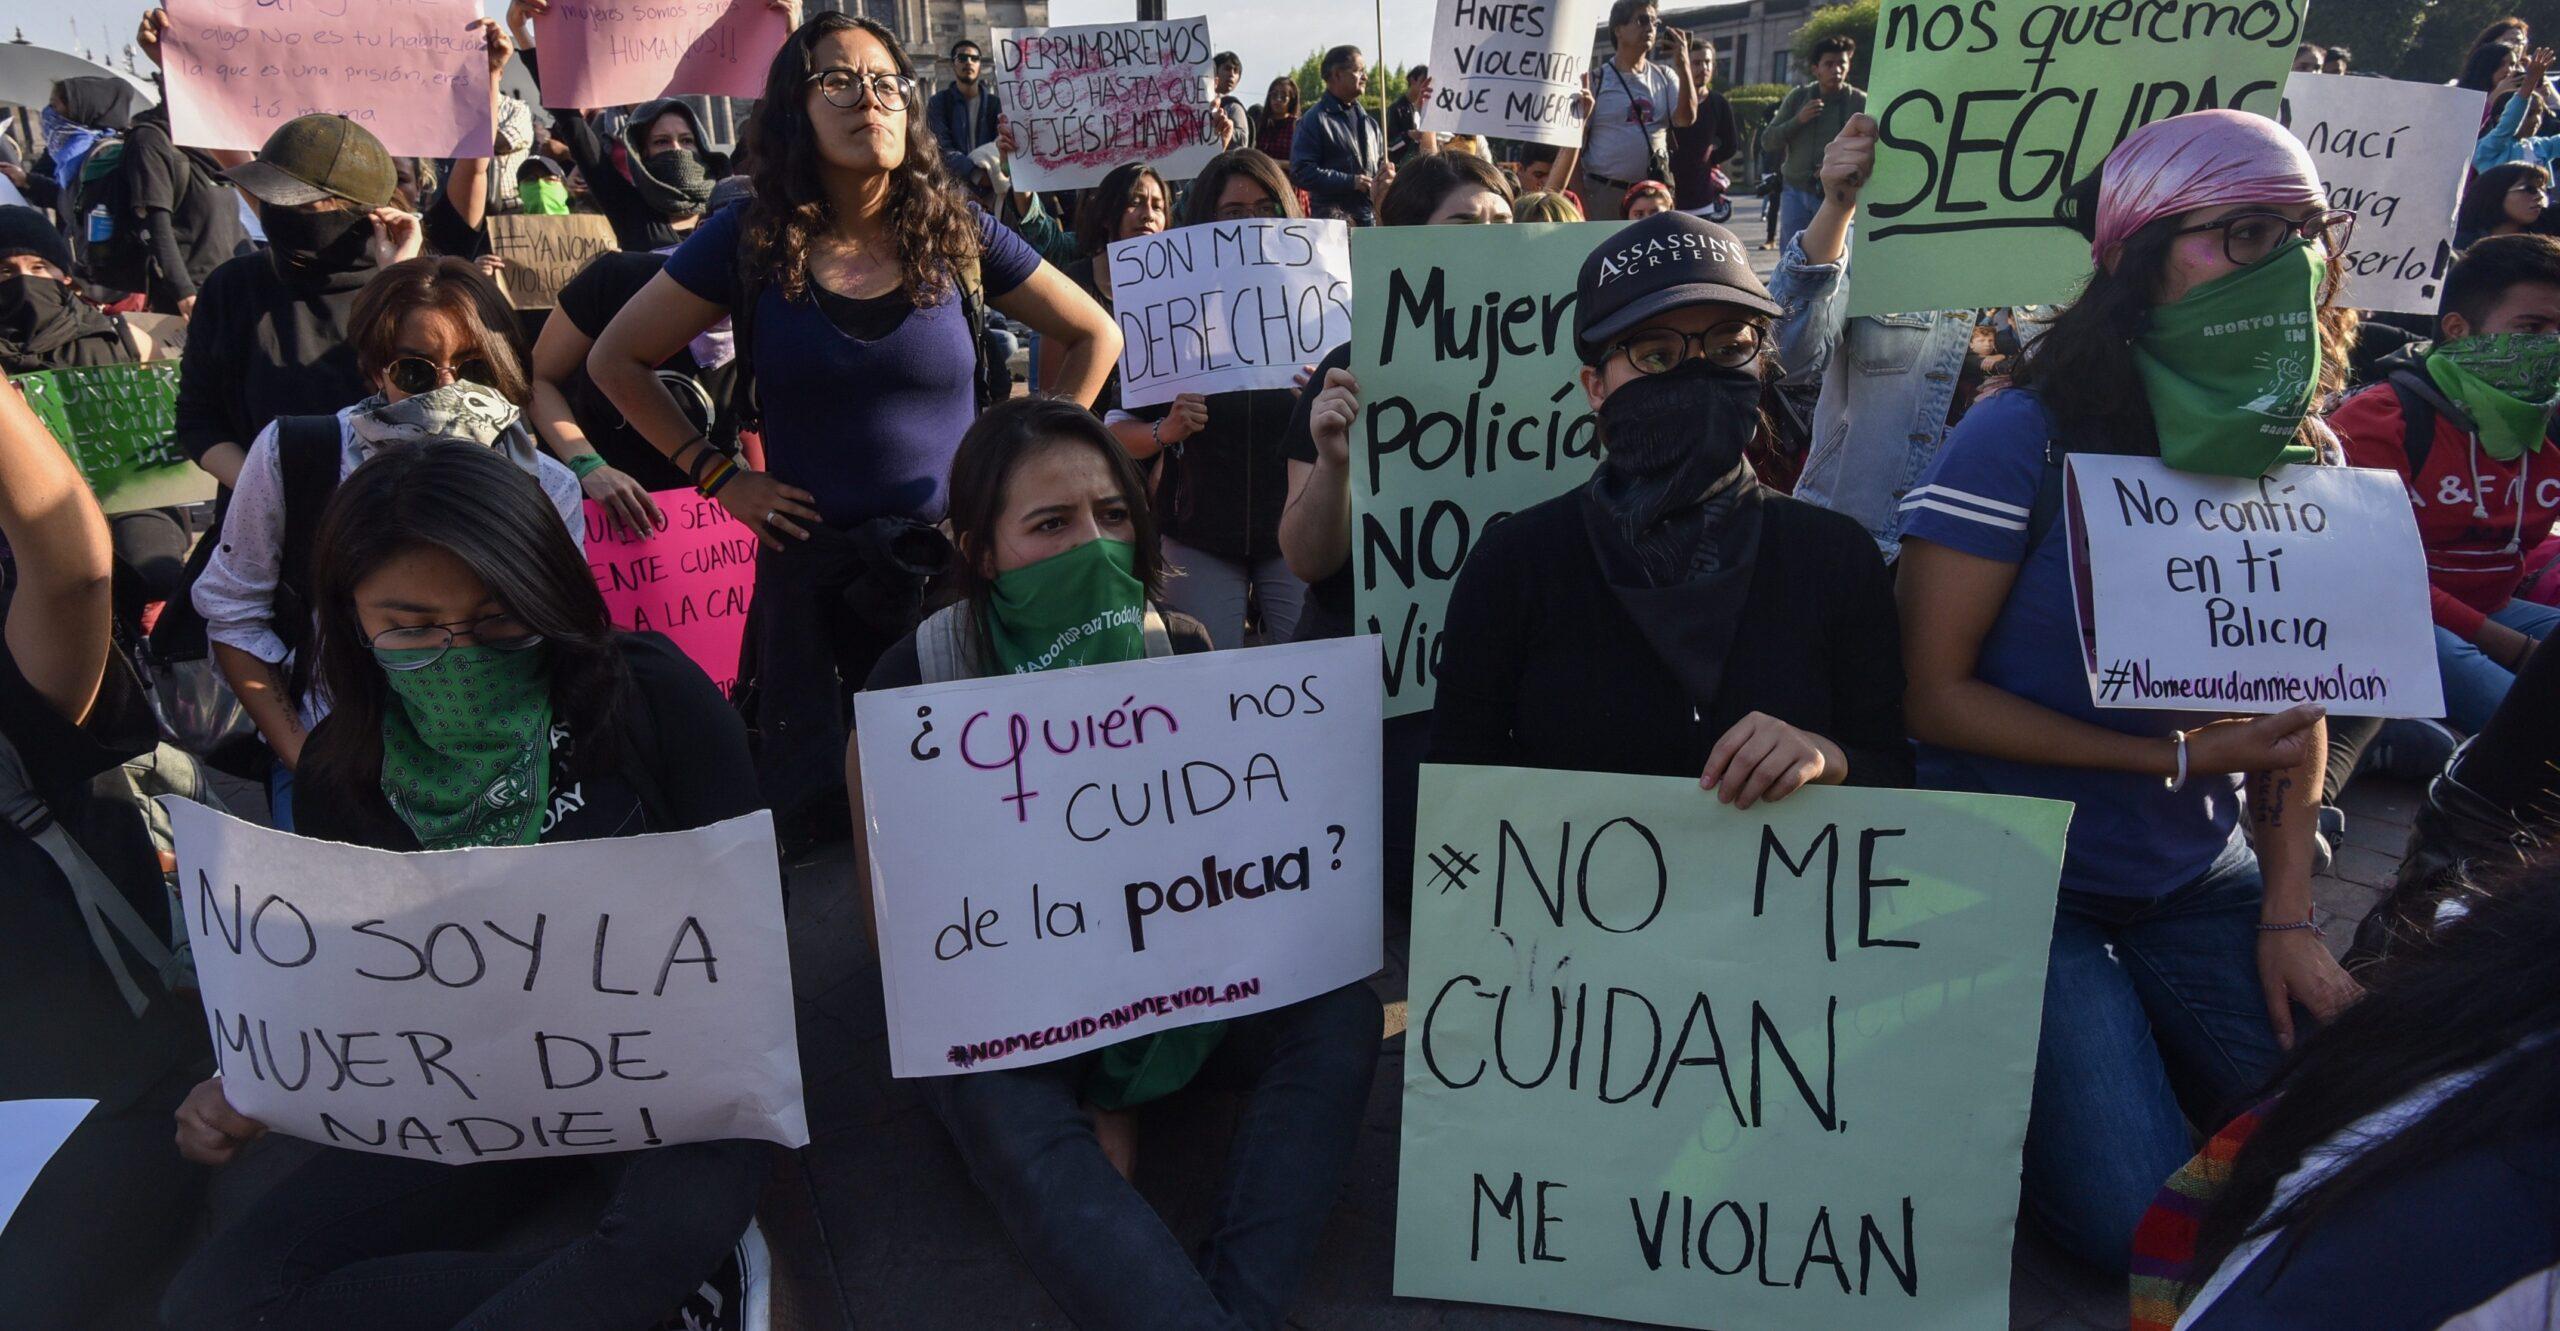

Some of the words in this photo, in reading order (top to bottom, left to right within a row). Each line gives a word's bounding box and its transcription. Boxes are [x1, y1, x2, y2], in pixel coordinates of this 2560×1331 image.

[632, 4, 688, 21] somos
[201, 28, 250, 51] algo
[261, 29, 302, 46] No
[314, 29, 344, 45] es
[352, 30, 381, 47] tu
[1001, 24, 1209, 72] DERRUMBAREMOS
[1884, 0, 1999, 53] nos
[2019, 0, 2300, 92] queremos
[217, 64, 249, 85] que
[260, 65, 280, 77] es
[293, 64, 328, 77] una
[432, 70, 469, 87] eres
[1000, 77, 1075, 111] TODO
[1086, 77, 1160, 107] HASTA
[1167, 75, 1210, 106] QUE
[1436, 87, 1491, 113] QUE
[1011, 108, 1100, 160] DEJÉIS
[1103, 114, 1126, 149] DE
[2307, 121, 2411, 158] nací
[1116, 232, 1193, 288] SON
[1213, 224, 1313, 269] MIS
[1598, 233, 1745, 288] ASSASSIN'S
[1627, 249, 1725, 275] CREED
[1379, 266, 1577, 390] Mujer
[2203, 315, 2274, 337] ABORTO
[2279, 311, 2312, 326] LEG
[2285, 328, 2306, 342] EN
[2112, 477, 2178, 526] No
[2195, 475, 2326, 533] confío
[2167, 555, 2221, 594] en
[2237, 539, 2283, 593] tí
[665, 595, 699, 628] LA
[707, 583, 755, 618] CAL
[2205, 597, 2327, 650] Policia
[1229, 675, 1326, 722] nos
[1065, 752, 1290, 842] CUIDA
[1754, 823, 1921, 962] ME
[199, 868, 316, 968] NO
[351, 913, 546, 991] SOY
[593, 913, 718, 996] LA
[935, 897, 1008, 961] de
[1033, 883, 1086, 939] la
[215, 1009, 478, 1100] MUJER
[535, 1030, 668, 1089] DE
[1471, 1171, 1568, 1263] ME
[1629, 1190, 1918, 1298] VIOLAN
